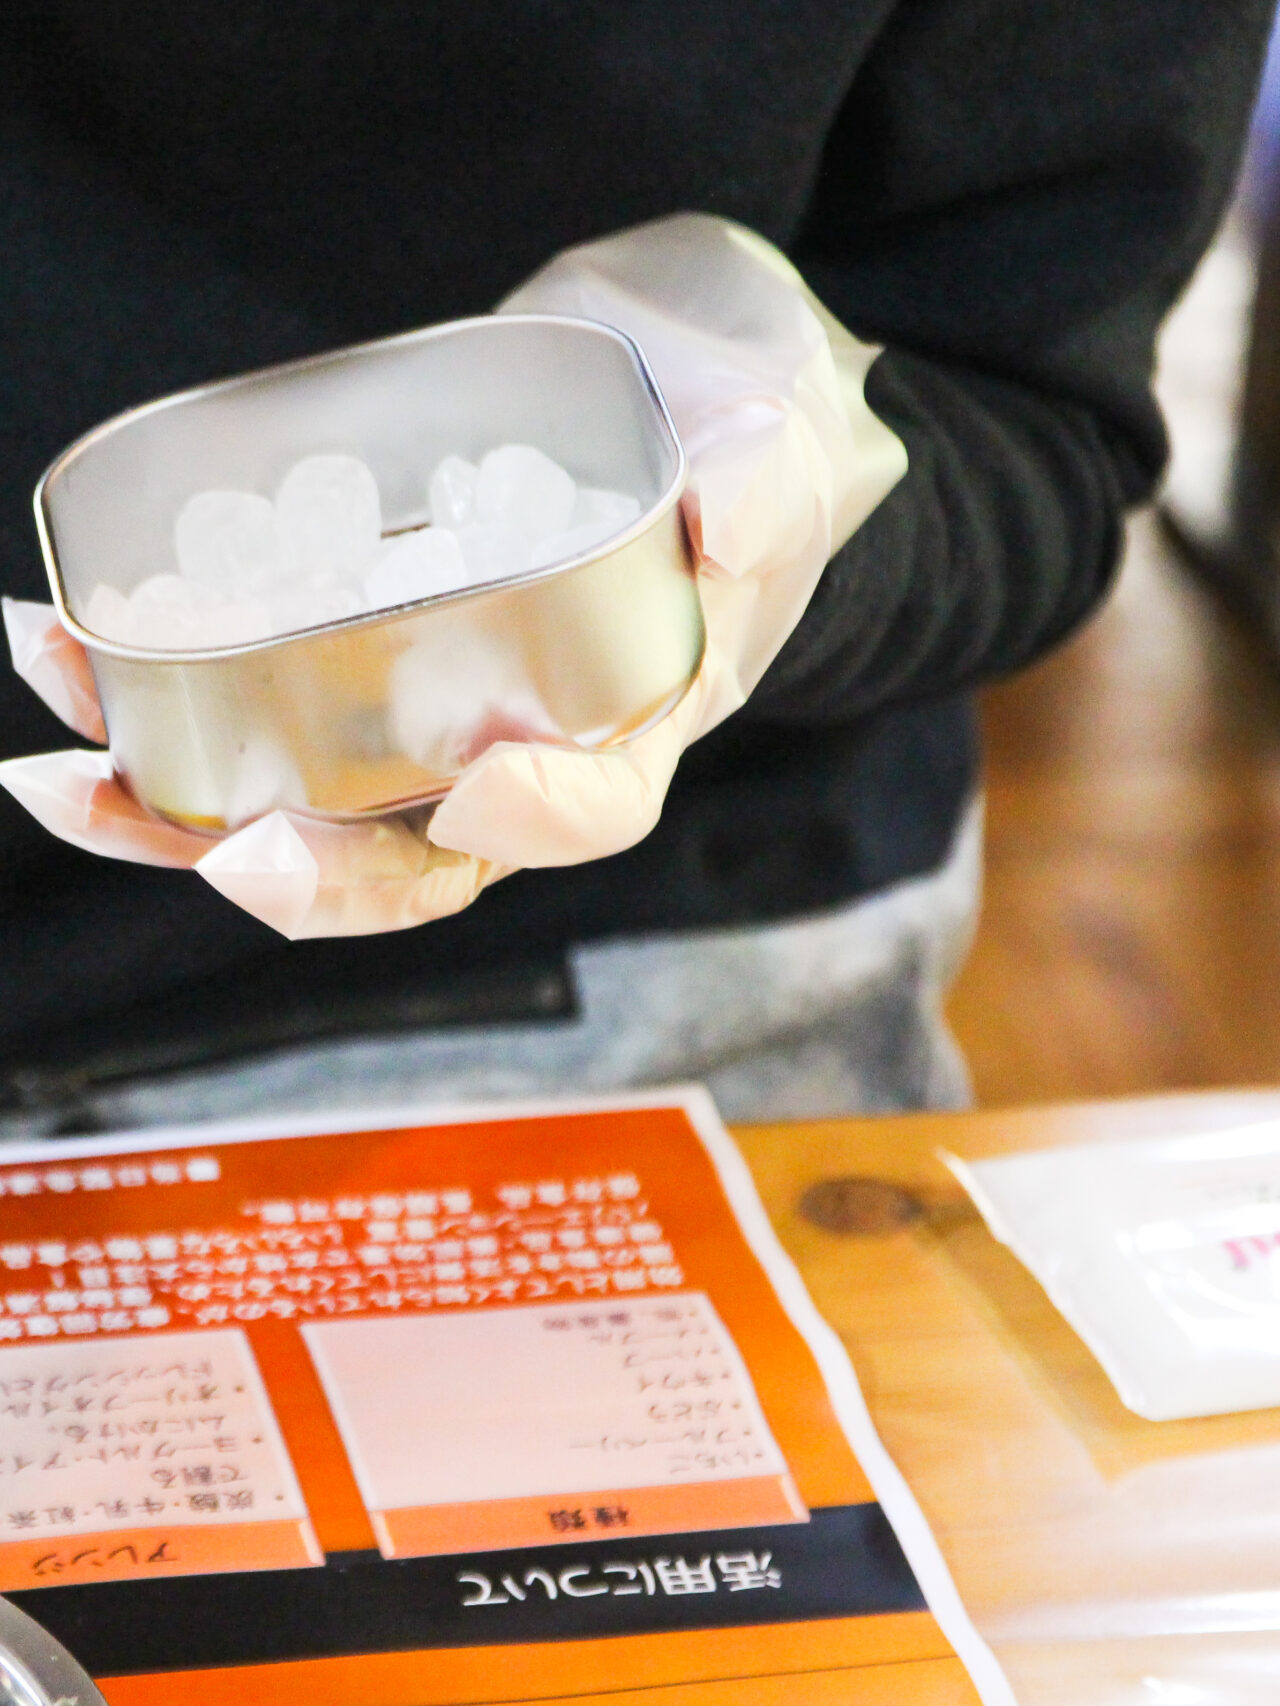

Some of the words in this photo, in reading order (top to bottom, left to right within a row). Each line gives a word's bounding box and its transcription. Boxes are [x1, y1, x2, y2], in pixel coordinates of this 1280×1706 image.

[150, 1464, 247, 1489] で割る
[31, 1541, 178, 1577] アレンジ
[456, 1550, 782, 1607] 活用について
